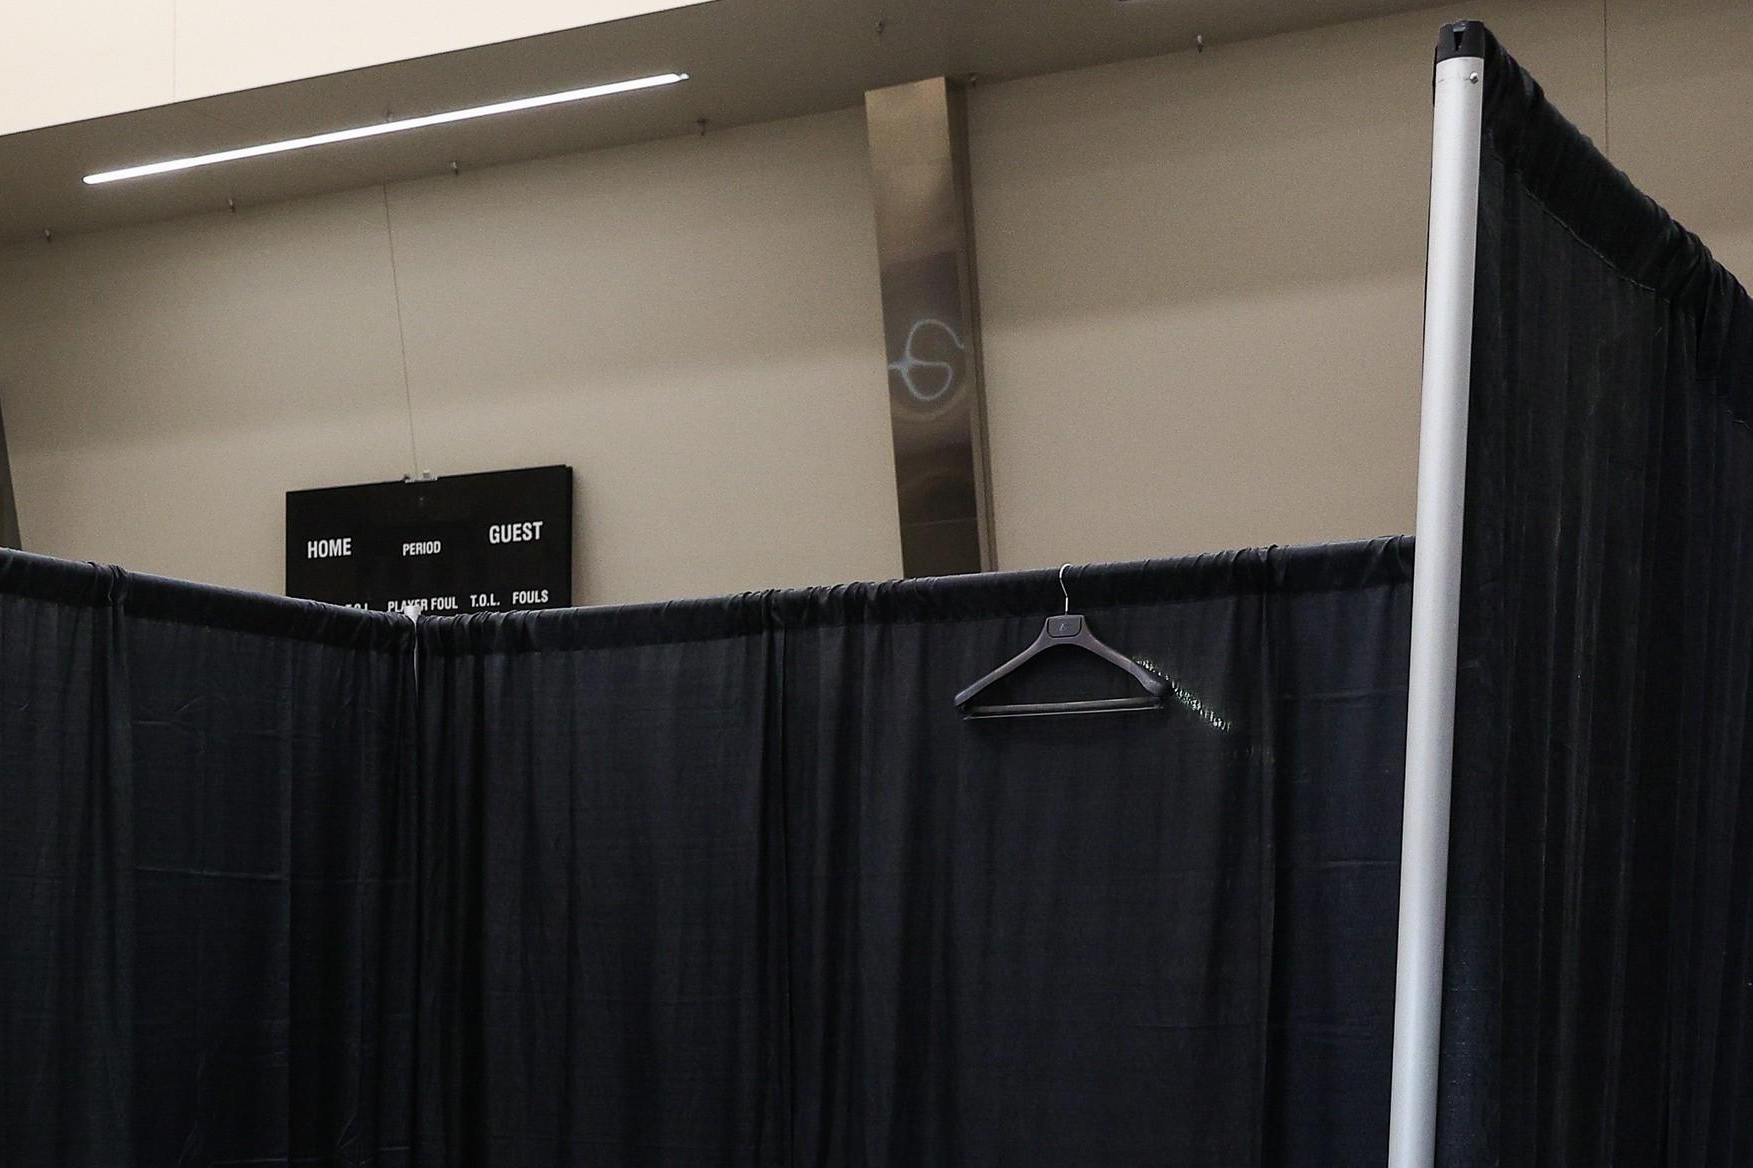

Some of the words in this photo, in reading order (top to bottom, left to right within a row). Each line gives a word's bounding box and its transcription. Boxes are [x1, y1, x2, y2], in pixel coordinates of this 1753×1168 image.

[489, 521, 543, 544] GUEST
[307, 538, 352, 559] HOME
[402, 541, 442, 556] PERIOD
[430, 597, 459, 610] FOUL
[469, 593, 501, 608] T.O.L.
[512, 589, 549, 605] FOULS
